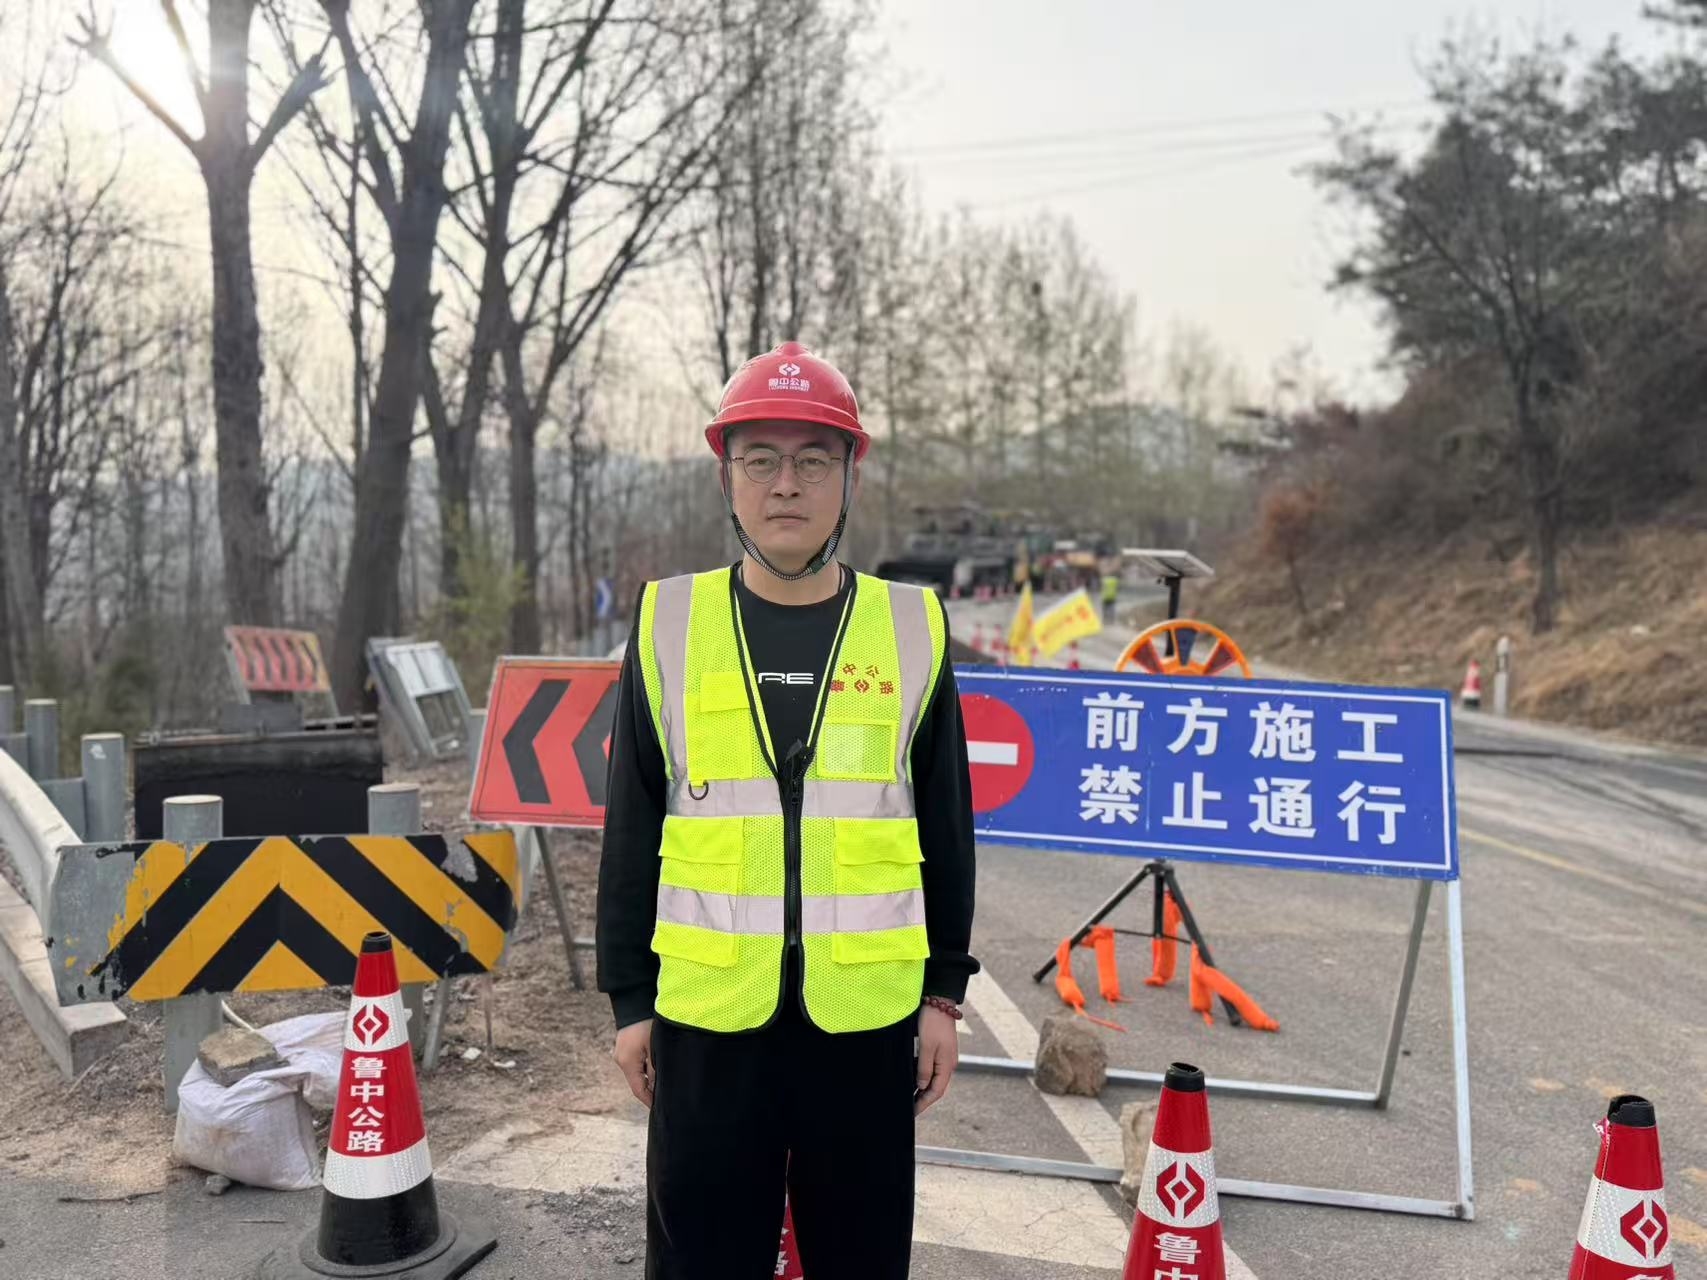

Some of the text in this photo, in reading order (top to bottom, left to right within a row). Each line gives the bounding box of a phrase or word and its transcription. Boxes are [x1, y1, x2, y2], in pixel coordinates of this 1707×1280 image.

[1083, 692, 1404, 764] 前方施工
[1079, 763, 1406, 845] 禁止通行
[347, 1056, 387, 1152] 鲁中公路
